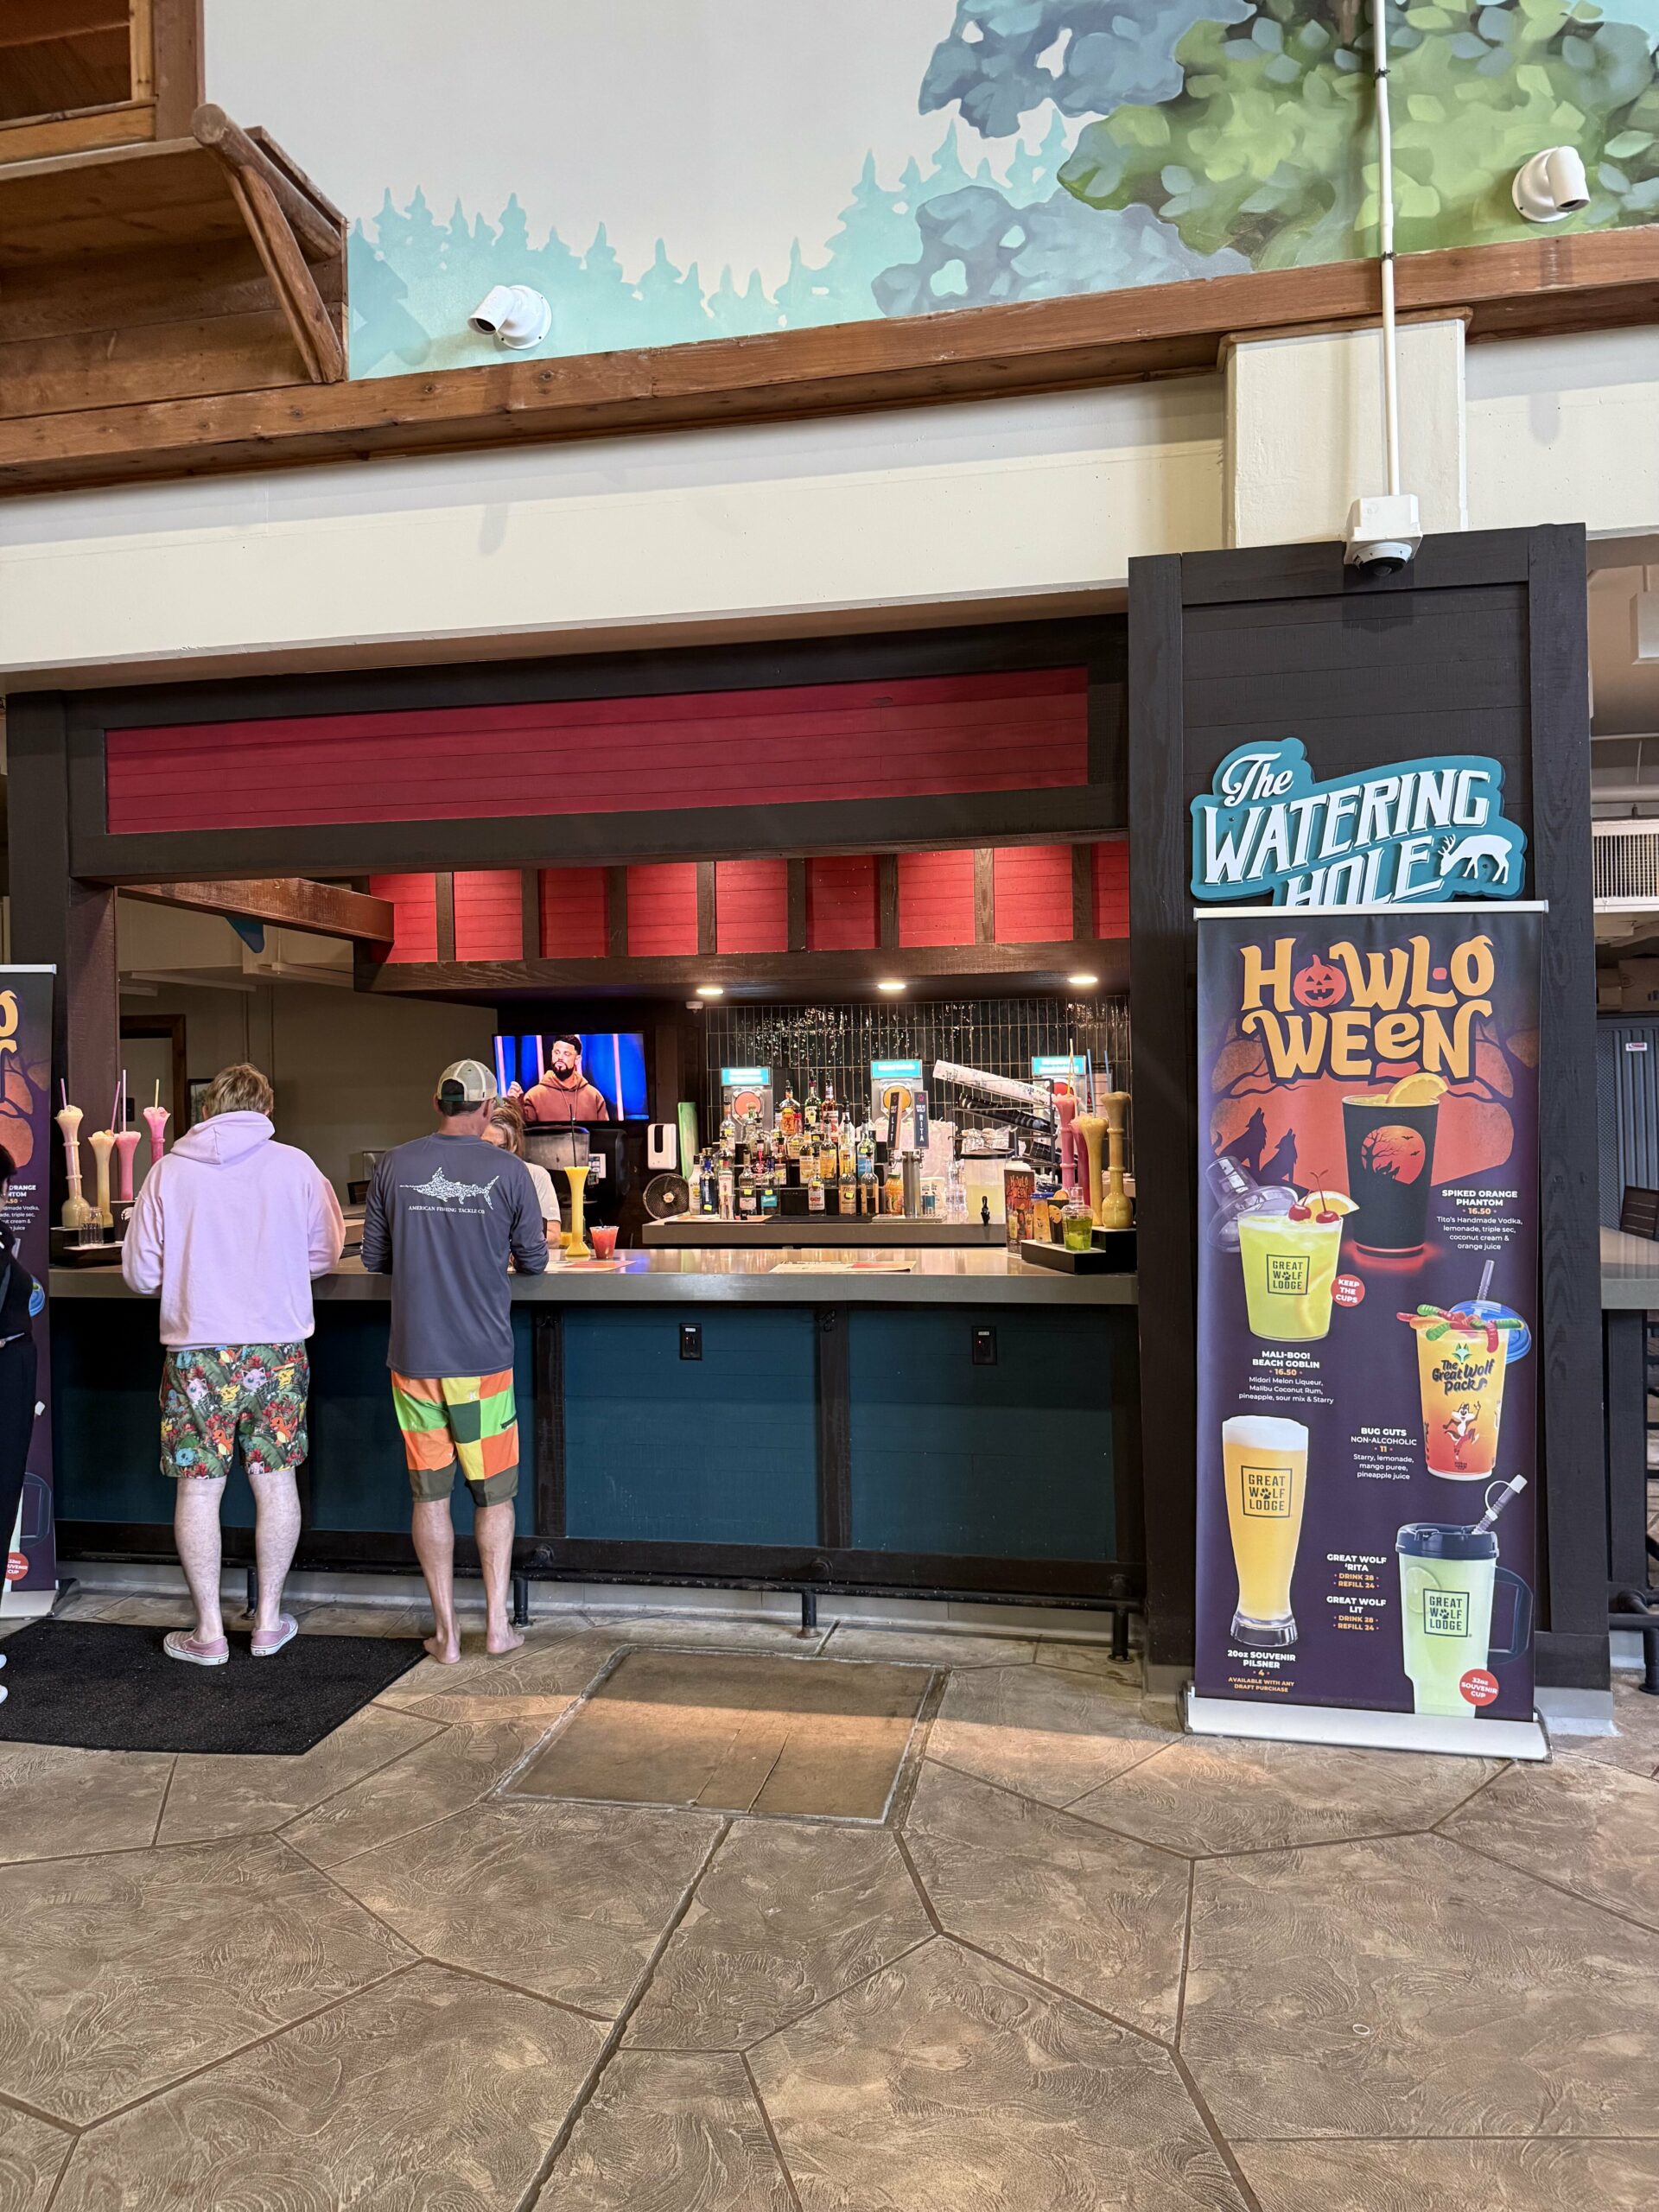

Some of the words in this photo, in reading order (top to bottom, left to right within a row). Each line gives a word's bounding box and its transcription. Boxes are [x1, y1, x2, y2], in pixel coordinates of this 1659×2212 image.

[1221, 752, 1294, 806] The
[1205, 769, 1491, 885] WATERING
[1286, 835, 1445, 906] HOLE
[1273, 1261, 1303, 1271] GREAT
[1274, 1281, 1302, 1290] LODGE
[1338, 1279, 1359, 1287] KEEP
[1336, 1294, 1358, 1303] CUPS
[1262, 1351, 1310, 1359] MALI-BOO!
[1253, 1358, 1283, 1367] BEACH
[1286, 1360, 1320, 1369] GOBLIN
[1442, 1360, 1458, 1370] The
[1433, 1367, 1462, 1382] Great
[1464, 1359, 1494, 1378] Wolf
[1313, 1396, 1334, 1405] Starry
[1351, 1436, 1417, 1446] NON-ALCOHOLIC
[1353, 1453, 1376, 1462] Starry,
[1249, 1474, 1286, 1486] GREAT
[1357, 1471, 1392, 1479] pineapple
[1249, 1498, 1285, 1511] LODGE
[1327, 1554, 1357, 1562] GREAT
[1359, 1555, 1387, 1564] WOLF
[1327, 1596, 1357, 1605] GREAT
[1430, 1596, 1463, 1608] GREAT
[1350, 1605, 1363, 1614] LIT
[1430, 1618, 1462, 1630] LODGE
[1227, 1649, 1249, 1658] 20oz
[1250, 1651, 1296, 1662] SOUVENIR
[1243, 1659, 1280, 1669] PILSNER
[1461, 1681, 1498, 1694] SOUVENIR
